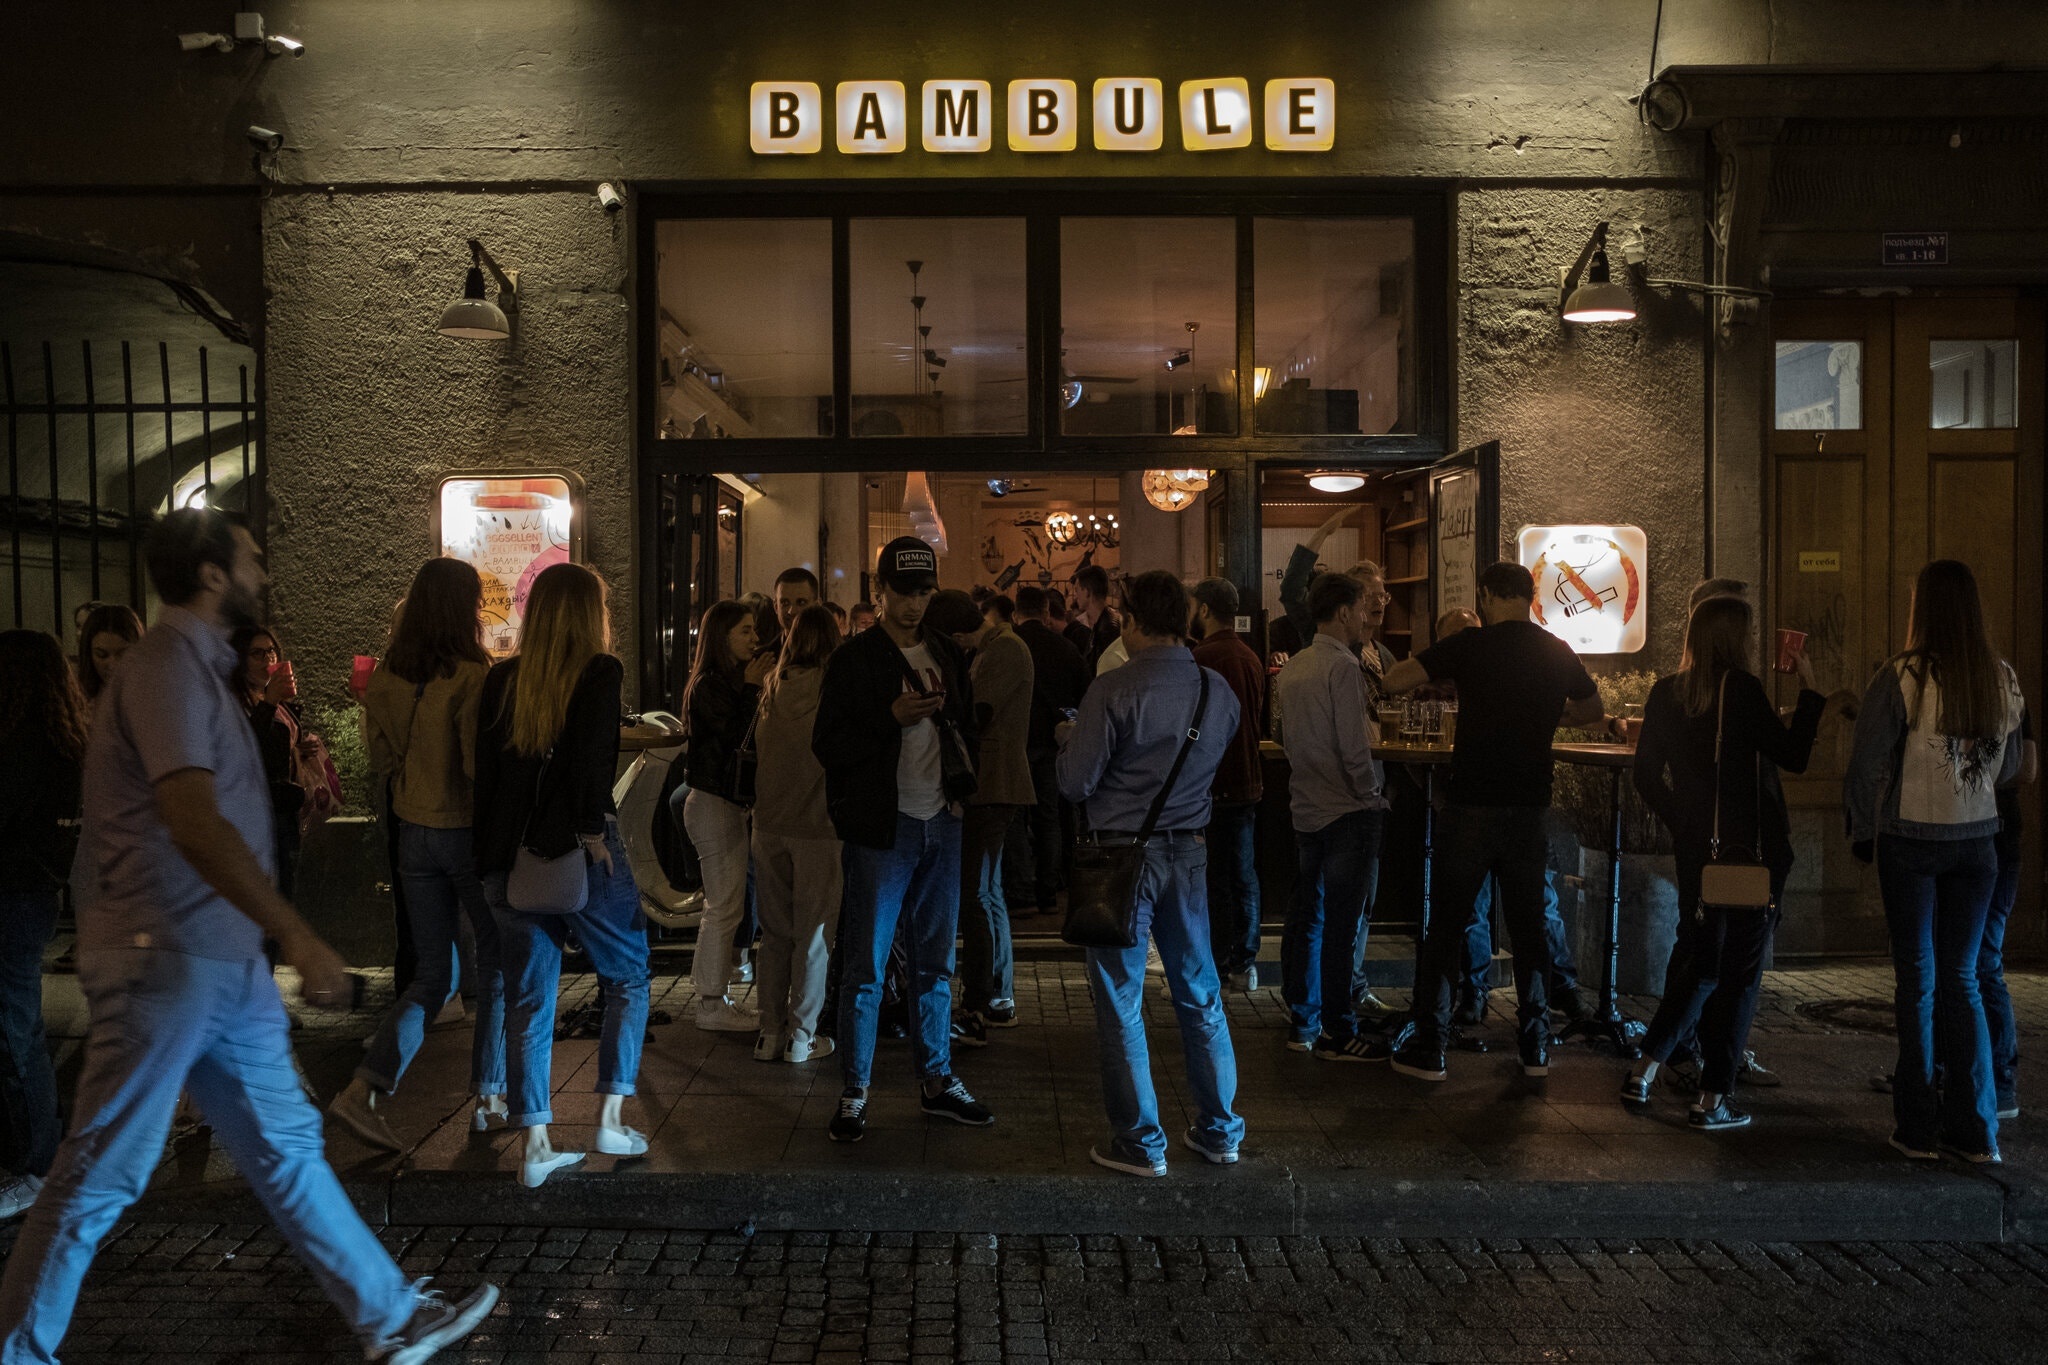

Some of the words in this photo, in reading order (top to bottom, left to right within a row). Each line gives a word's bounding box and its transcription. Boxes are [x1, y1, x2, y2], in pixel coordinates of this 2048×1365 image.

[769, 87, 1317, 140] BAMBULE
[1885, 239, 1924, 248] подъезд
[1912, 250, 1936, 261] 1-16
[1815, 432, 1826, 455] 7
